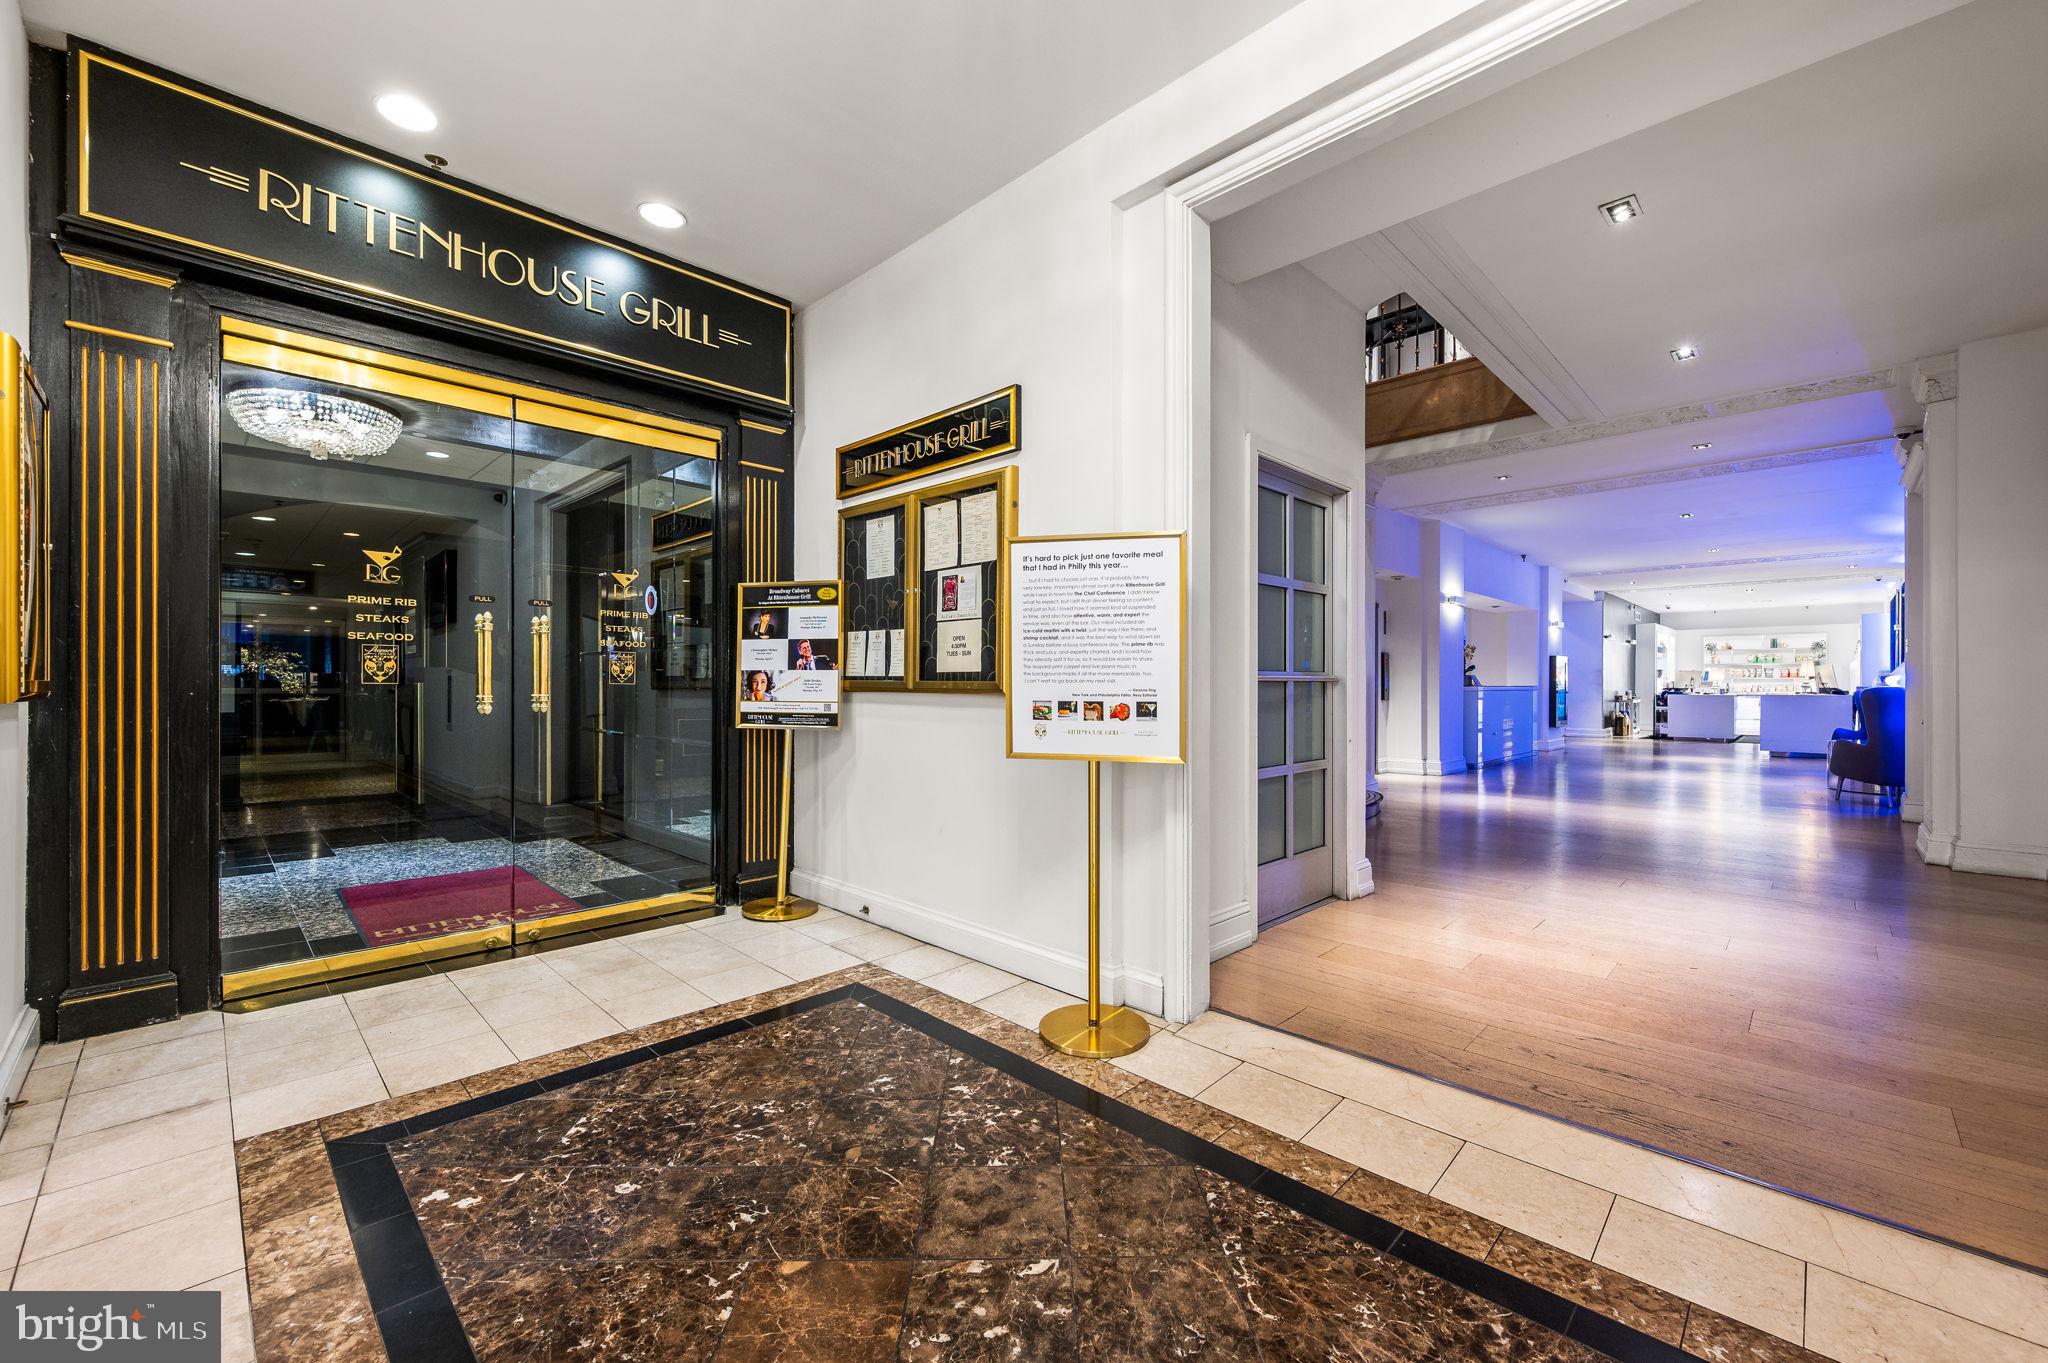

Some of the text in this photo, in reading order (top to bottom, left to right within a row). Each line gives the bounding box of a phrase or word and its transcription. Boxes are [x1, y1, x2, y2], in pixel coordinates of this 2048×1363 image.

[257, 167, 721, 349] RITTENHOUSE GRILL
[855, 417, 991, 478] RITTENHOUSE GRILL
[1062, 553, 1079, 562] pick
[1080, 553, 1094, 561] just
[1068, 562, 1087, 571] Philly
[347, 595, 417, 607] PRIME RIB
[355, 614, 410, 624] STEAKS
[600, 609, 649, 620] PRIME RIB
[605, 624, 644, 634] STEAKS
[347, 631, 414, 642] SEAFOOD
[599, 639, 647, 648] SEAFOOD
[962, 649, 972, 657] SUN
